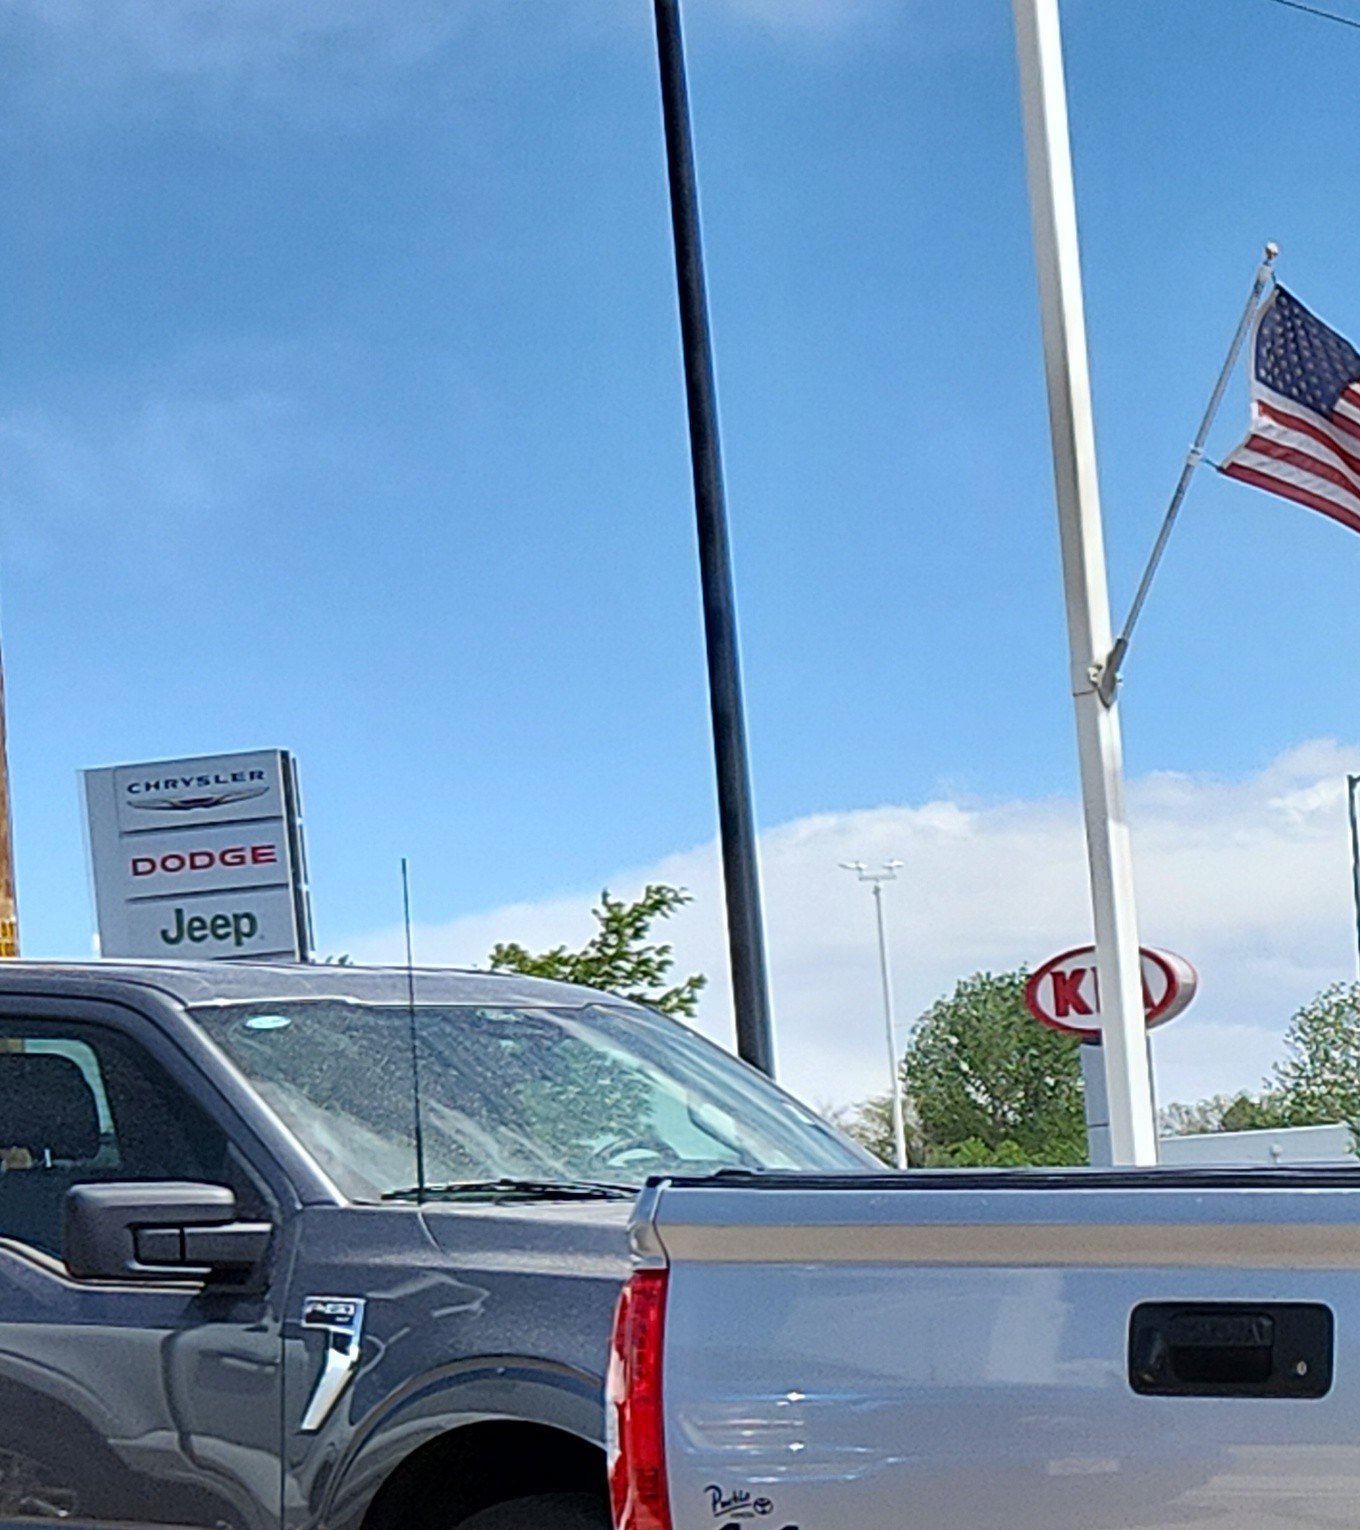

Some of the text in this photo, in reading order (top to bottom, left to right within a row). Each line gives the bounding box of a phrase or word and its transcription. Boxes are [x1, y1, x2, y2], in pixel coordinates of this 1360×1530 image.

[126, 769, 266, 795] CHRYSLER
[131, 844, 278, 877] DODGE
[160, 907, 259, 947] Jeep
